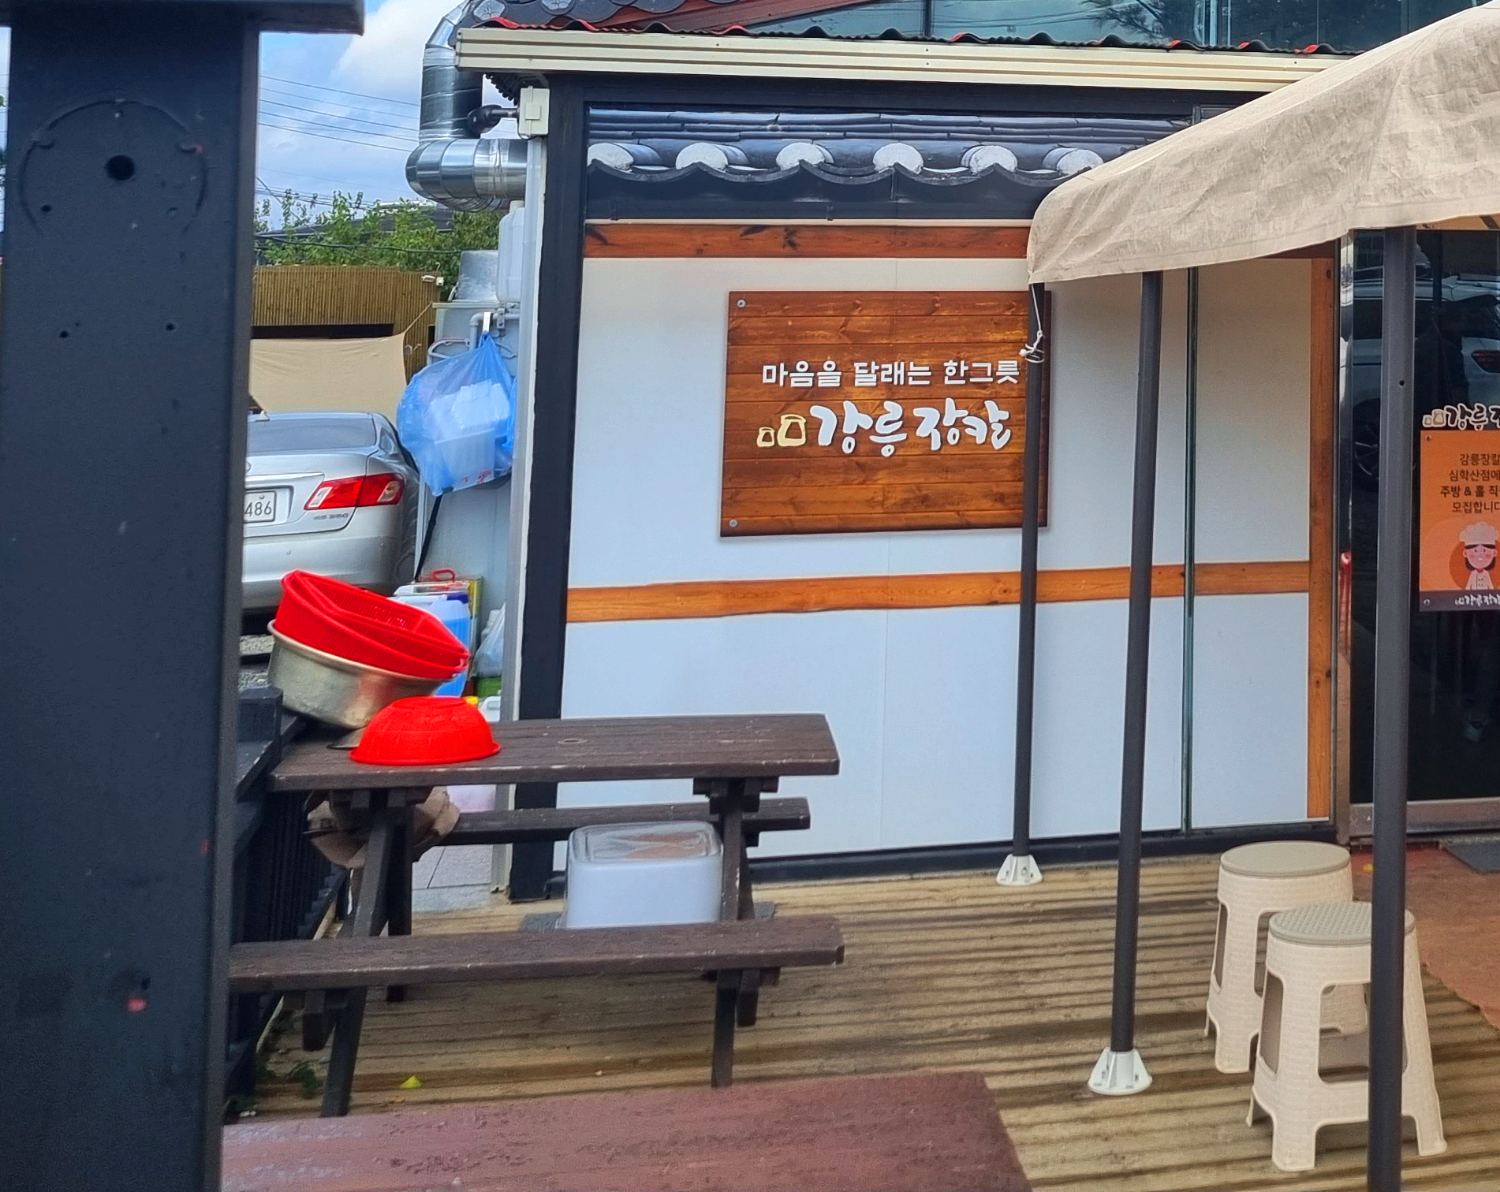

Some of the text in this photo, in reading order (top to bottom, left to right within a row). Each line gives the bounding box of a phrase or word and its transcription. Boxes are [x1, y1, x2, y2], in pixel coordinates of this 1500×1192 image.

[762, 359, 1020, 388] 마음을 달래는 한그릇
[1460, 453, 1500, 466] 강릉장칼
[1440, 484, 1461, 498] 주방
[1464, 486, 1472, 496] &
